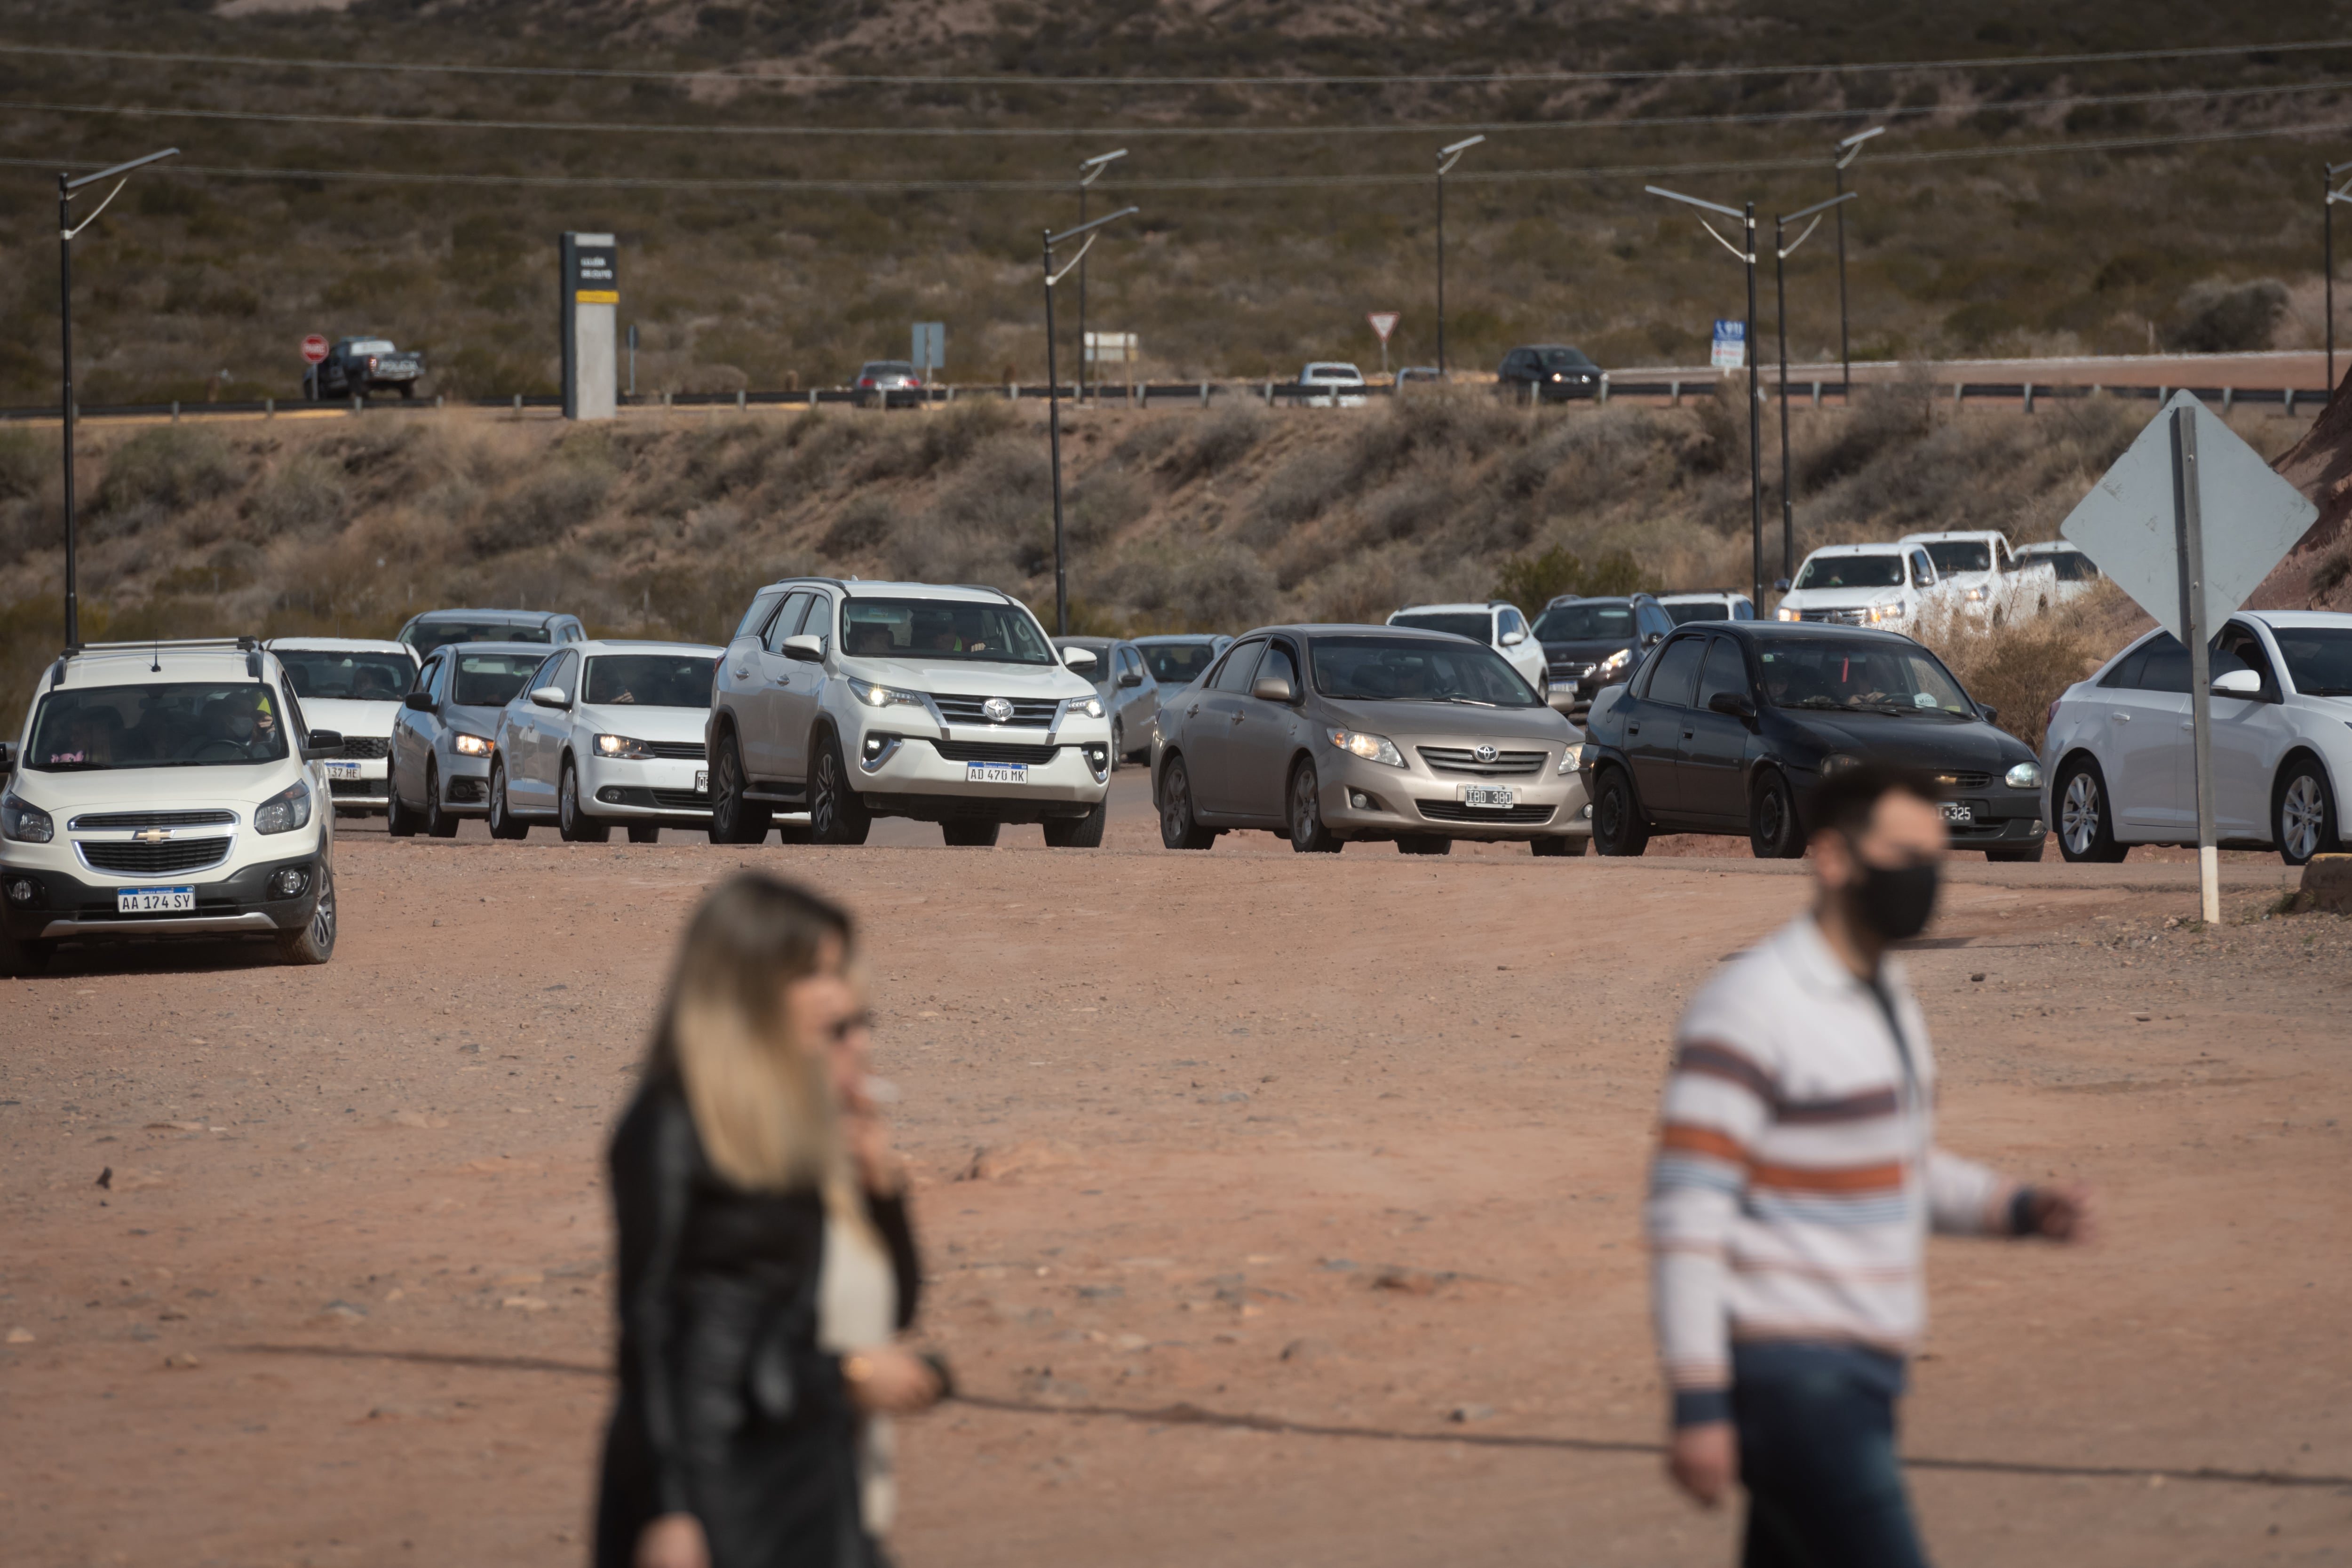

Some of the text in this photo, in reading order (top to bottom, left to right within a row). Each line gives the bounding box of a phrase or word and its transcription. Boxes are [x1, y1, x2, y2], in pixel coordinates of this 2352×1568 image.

[346, 768, 358, 778] HE
[971, 769, 1024, 782] AD 470 MK
[1468, 790, 1511, 804] IBD 380
[1951, 807, 1971, 820] 325
[122, 894, 190, 910] AA 174 SY
